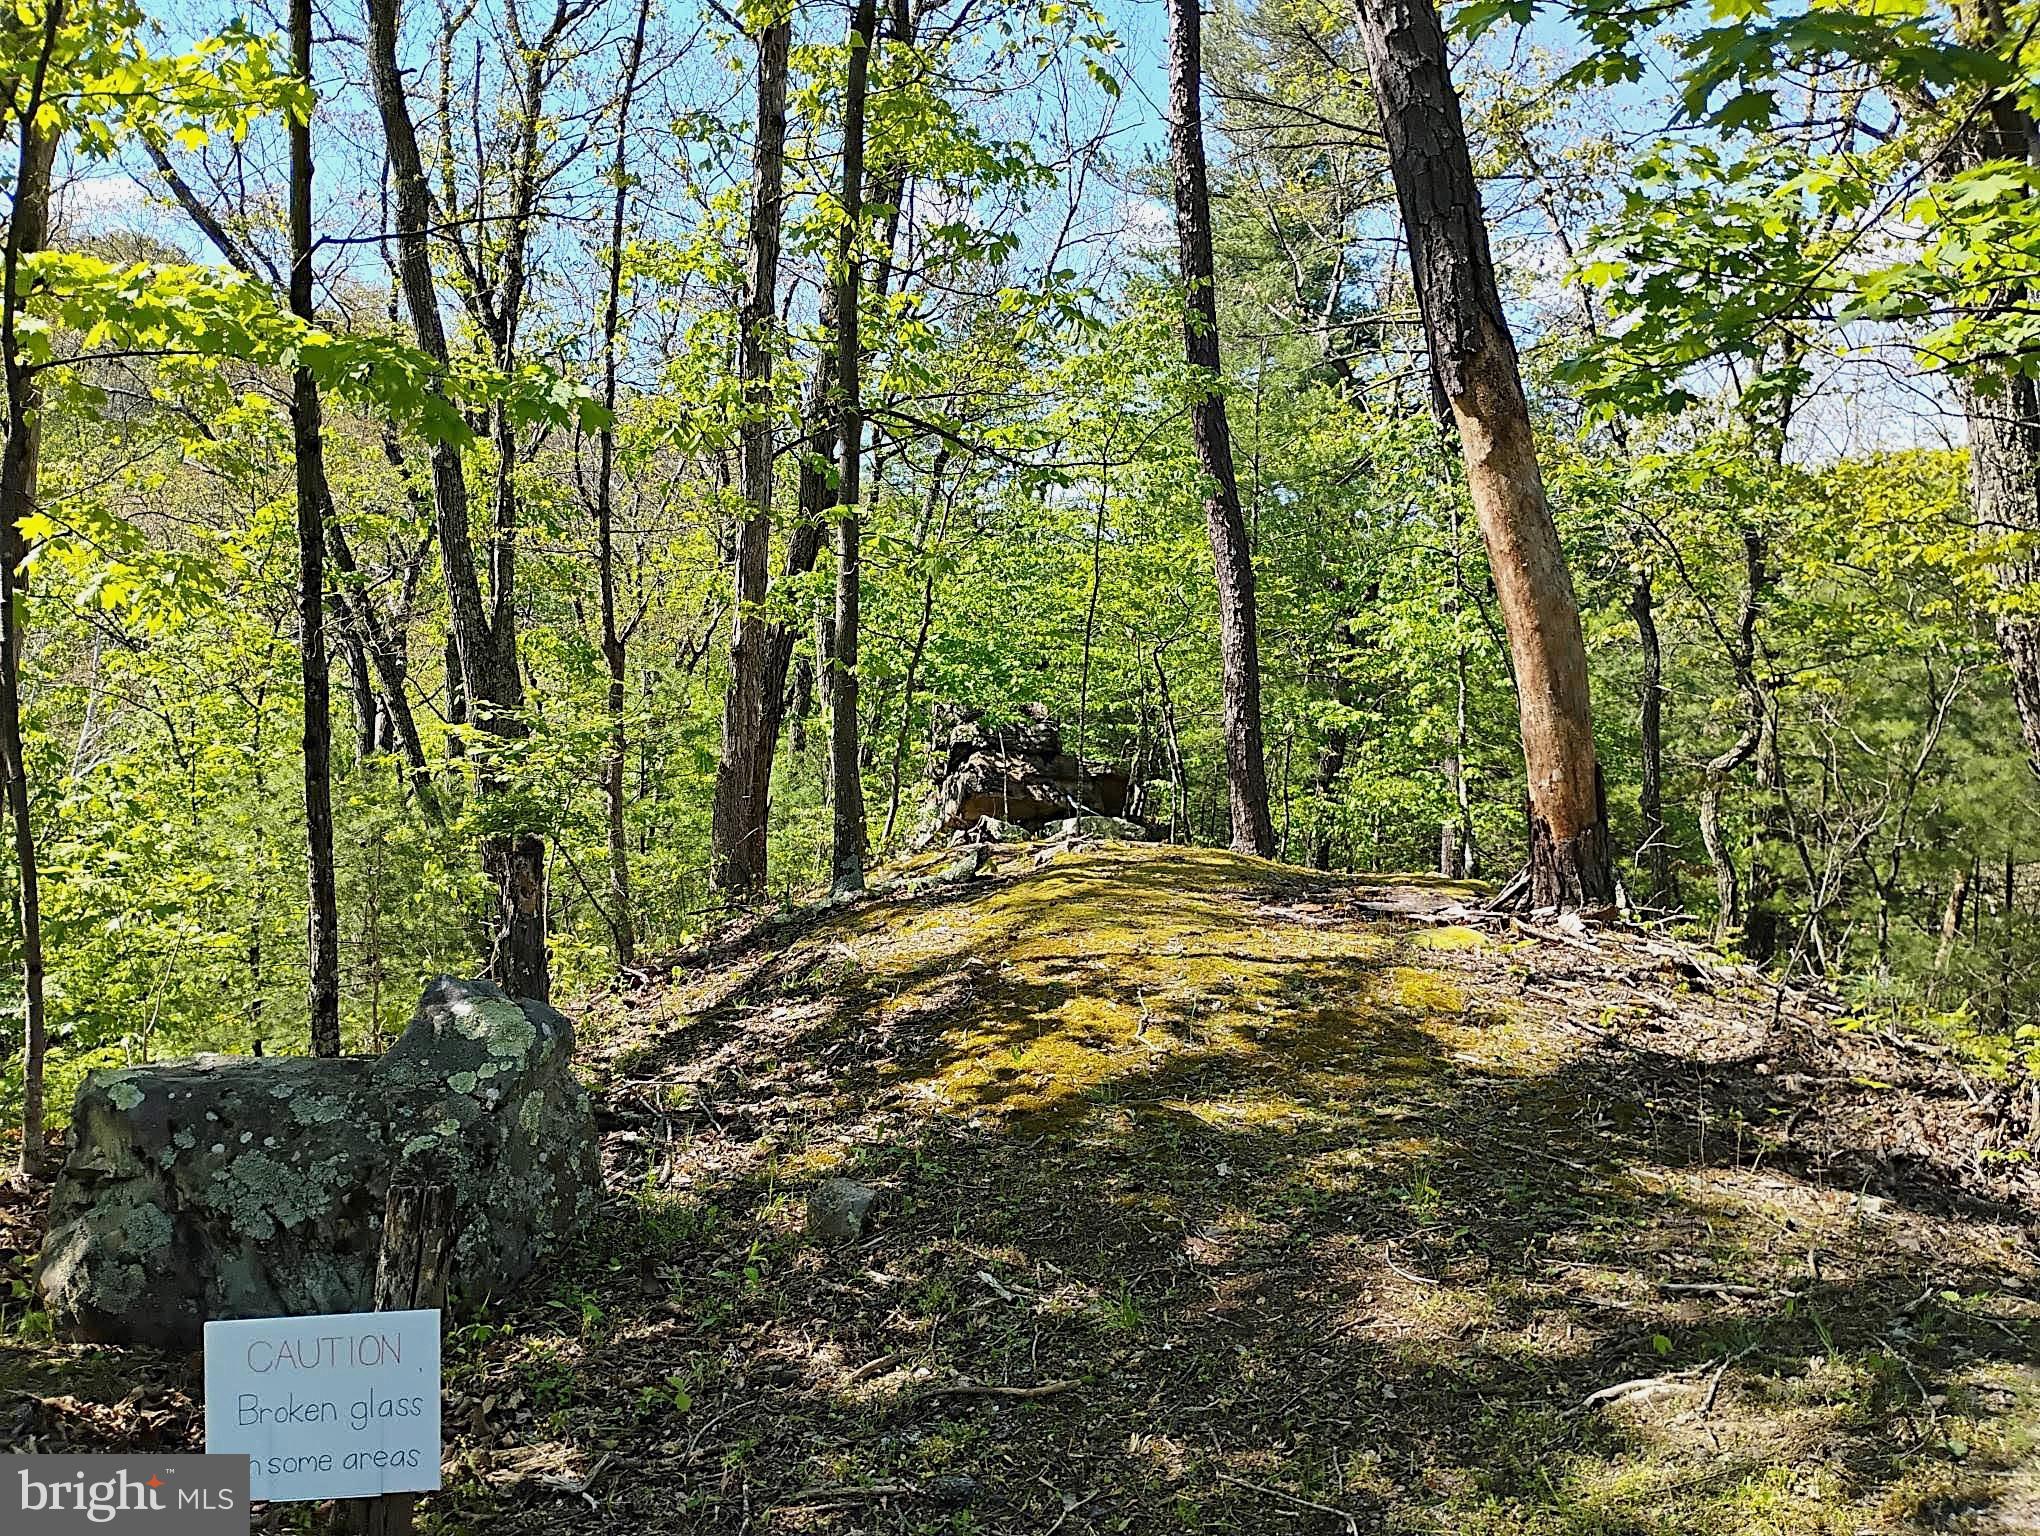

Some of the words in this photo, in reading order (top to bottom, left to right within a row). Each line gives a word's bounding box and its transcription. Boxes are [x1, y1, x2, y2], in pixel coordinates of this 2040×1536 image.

[247, 1332, 401, 1373] CAUTION
[238, 1392, 338, 1426] Broken
[350, 1387, 424, 1431] glass
[267, 1453, 333, 1475] some
[343, 1449, 421, 1471] areas
